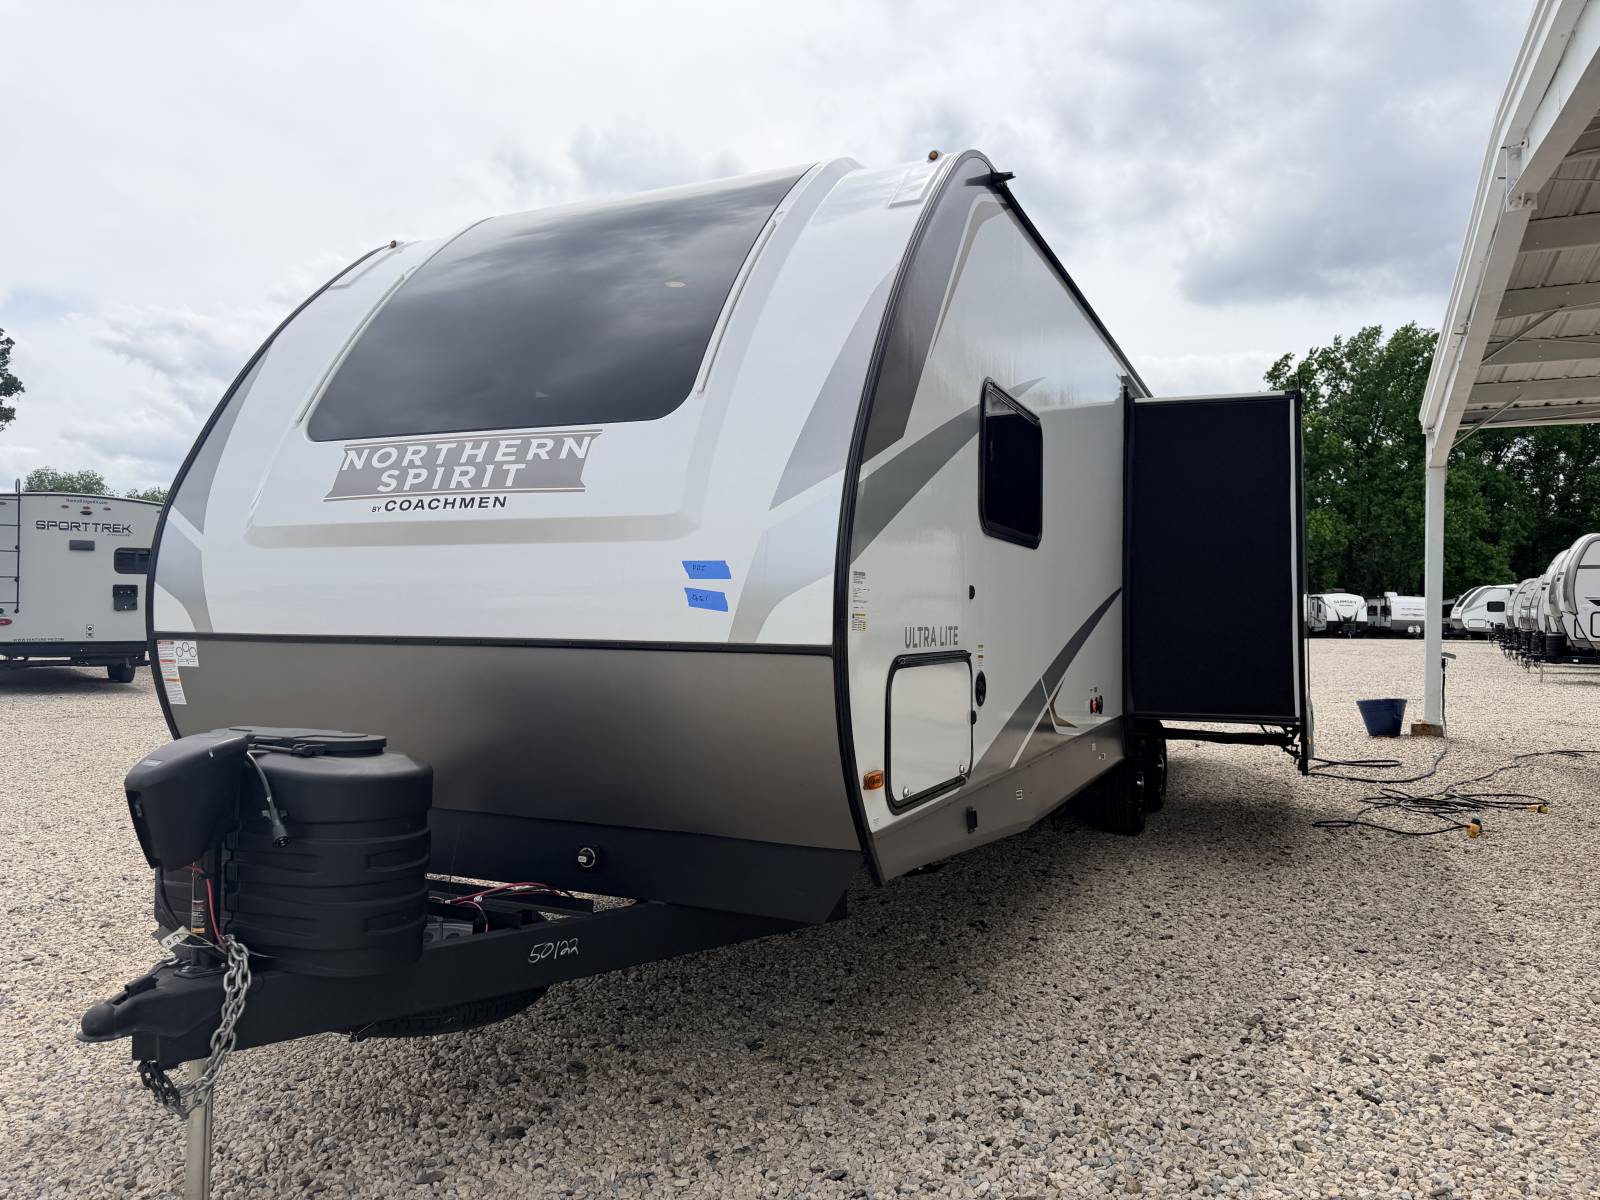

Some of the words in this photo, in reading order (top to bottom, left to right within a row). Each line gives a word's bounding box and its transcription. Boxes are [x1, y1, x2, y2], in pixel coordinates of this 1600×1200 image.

[341, 436, 592, 471] NORTHERN
[376, 463, 527, 493] SPIRIT
[371, 505, 382, 513] BY
[384, 495, 507, 512] COACHMEN
[35, 520, 133, 534] SPORTTREK
[904, 625, 937, 649] ULTRA
[939, 625, 959, 647] LITE
[528, 937, 579, 963] 50122
